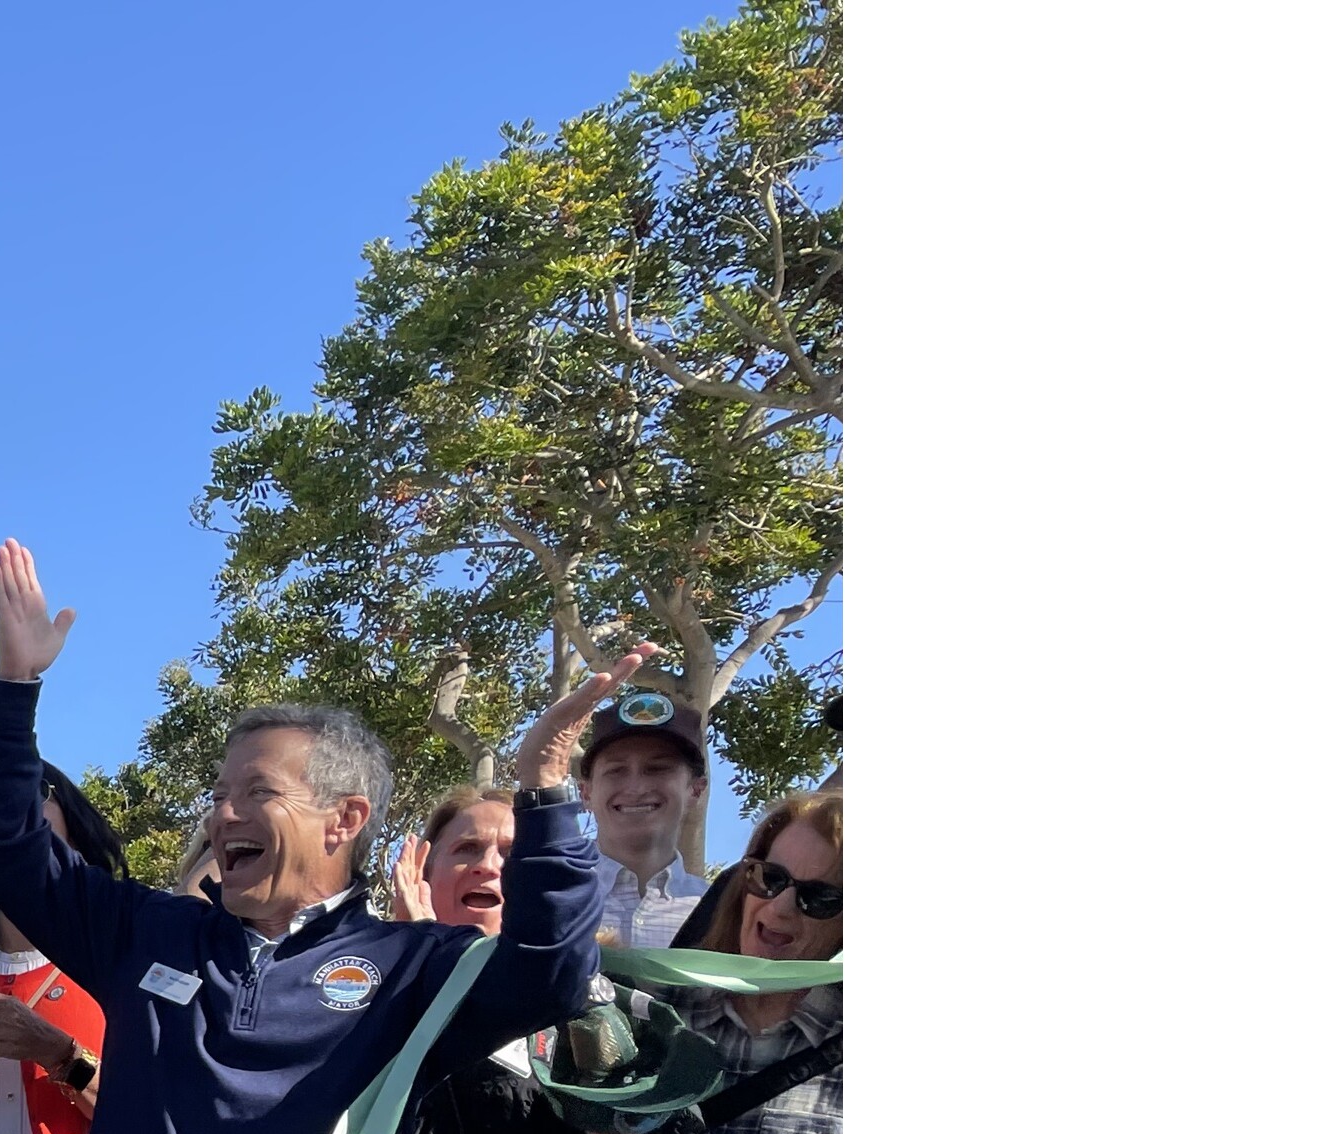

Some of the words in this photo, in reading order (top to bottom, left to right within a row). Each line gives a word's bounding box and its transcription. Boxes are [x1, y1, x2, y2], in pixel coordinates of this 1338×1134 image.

[315, 960, 362, 985] MANHATTAN
[362, 963, 378, 985] BEACH
[328, 1000, 360, 1008] MAYOR
